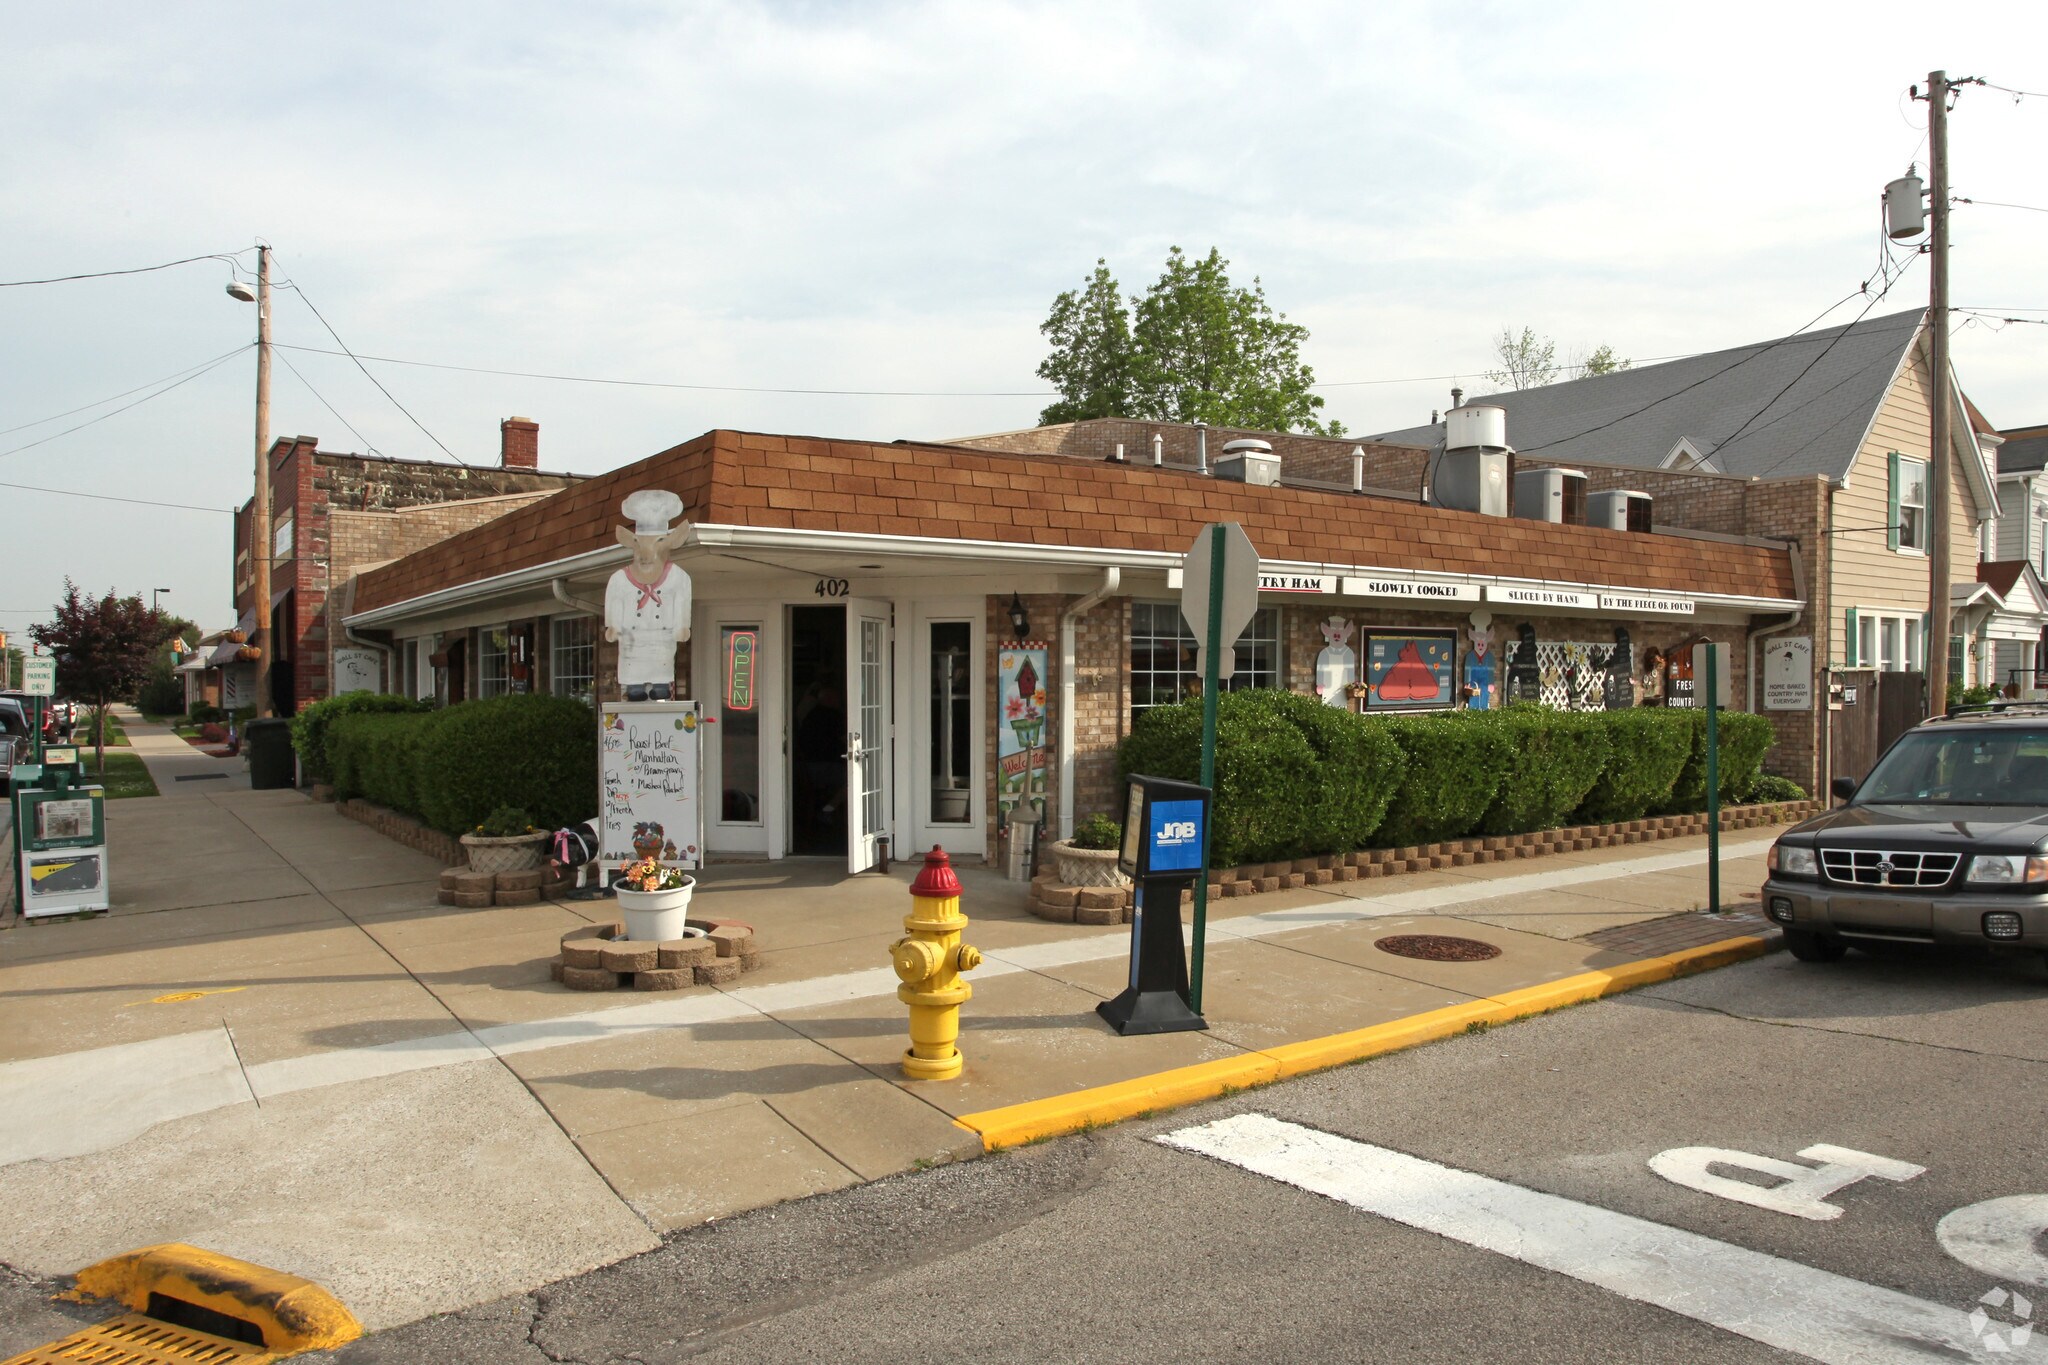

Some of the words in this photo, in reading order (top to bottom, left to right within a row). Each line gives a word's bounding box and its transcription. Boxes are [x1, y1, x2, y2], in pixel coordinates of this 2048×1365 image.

[815, 579, 850, 597] 402
[1292, 578, 1321, 589] HAM
[1369, 582, 1414, 595] SLOWLY
[1417, 585, 1459, 597] COOKED
[1508, 590, 1540, 602] SLICED
[1543, 593, 1553, 602] BY
[1556, 594, 1580, 604] HAND
[1603, 598, 1614, 607] BY
[1616, 599, 1633, 608] THE
[1635, 600, 1657, 609] PIECE
[1658, 602, 1669, 610] OR
[1766, 643, 1782, 655] WALL
[336, 654, 353, 664] WALL
[733, 636, 752, 706] OPEN
[629, 725, 651, 750] Roast
[654, 730, 674, 750] Beef
[635, 750, 679, 764] Manhattan
[1004, 752, 1046, 773] Welcme
[1157, 821, 1196, 839] JOB
